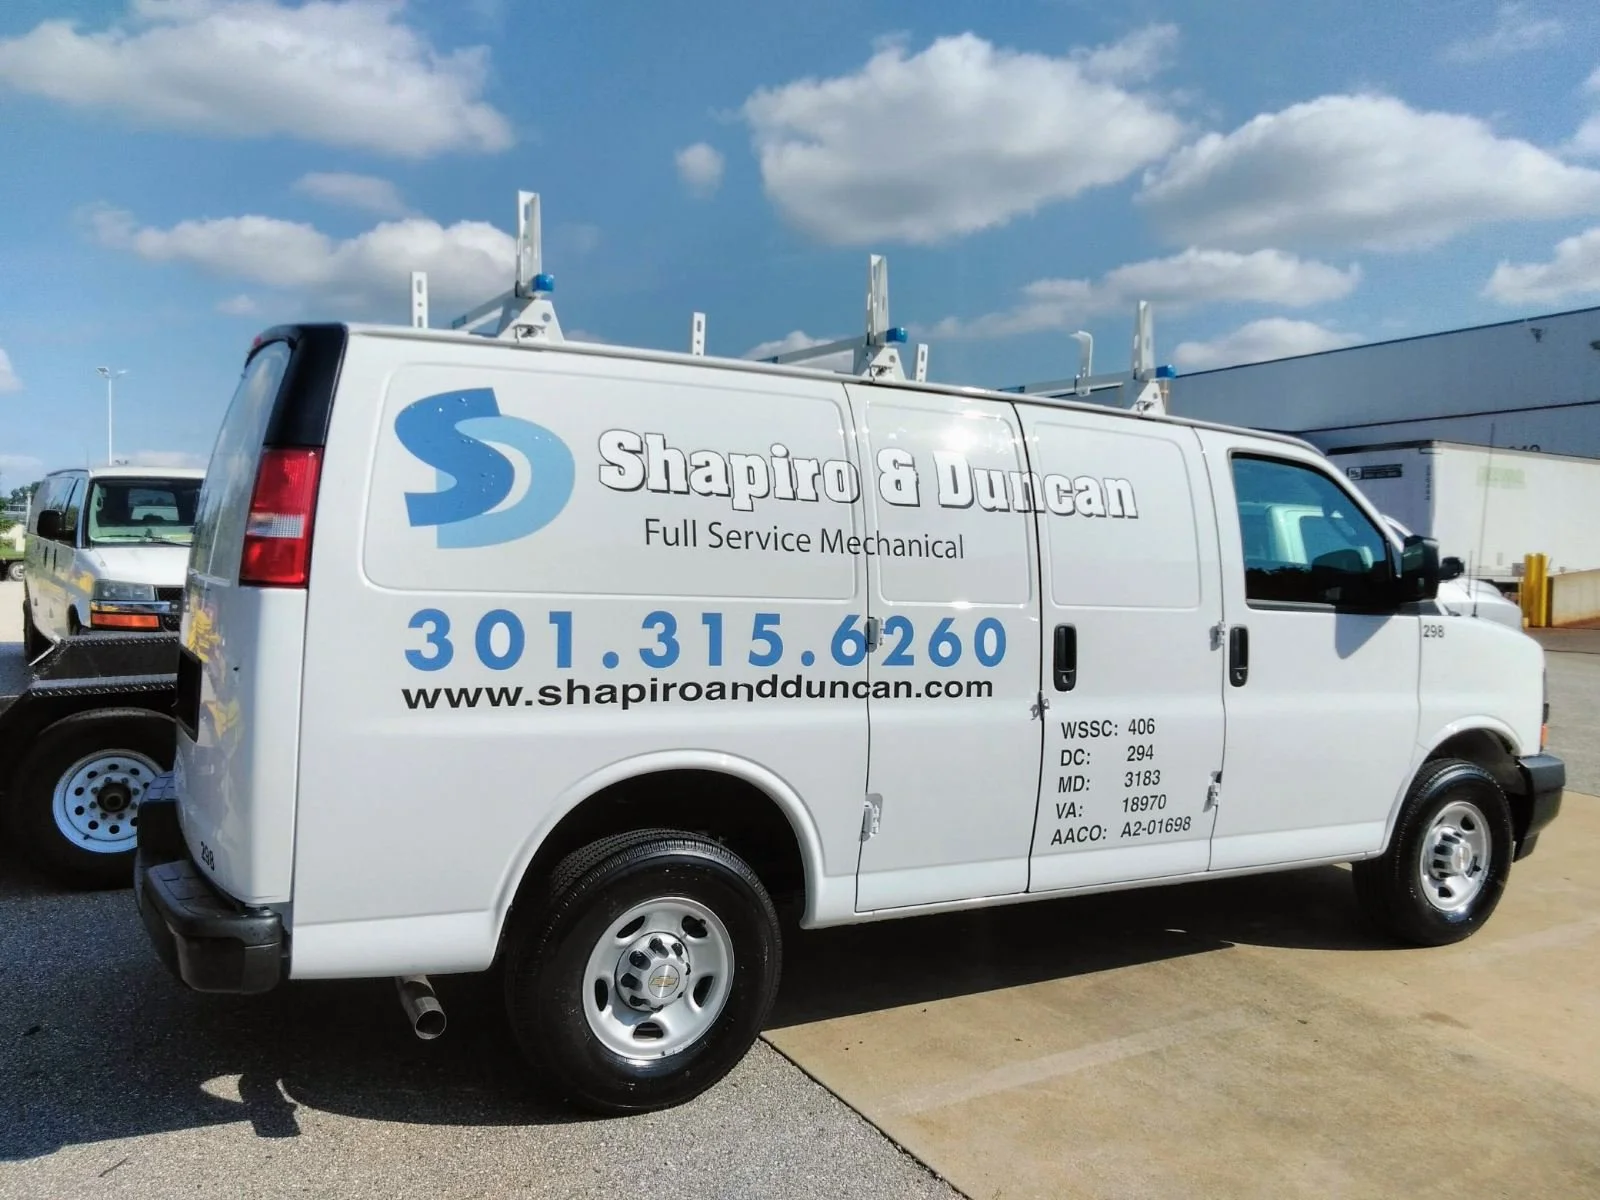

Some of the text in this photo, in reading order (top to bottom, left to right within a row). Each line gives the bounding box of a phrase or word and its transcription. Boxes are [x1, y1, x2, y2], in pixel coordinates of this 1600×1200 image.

[598, 429, 1139, 519] Shapiro & Duncan
[645, 518, 965, 560] Full Service Mechanical
[404, 607, 1007, 672] 301.315.6260
[1423, 624, 1445, 638] 298
[401, 673, 993, 711] www.shapiroandduncan.com
[1061, 717, 1156, 739] WSSC: 406
[1060, 744, 1154, 767] DC: 294
[1058, 769, 1161, 793] MD: 3183
[1056, 793, 1167, 820] VA: 18970
[1050, 815, 1192, 846] AACO: A2-01698
[200, 840, 215, 872] 298
